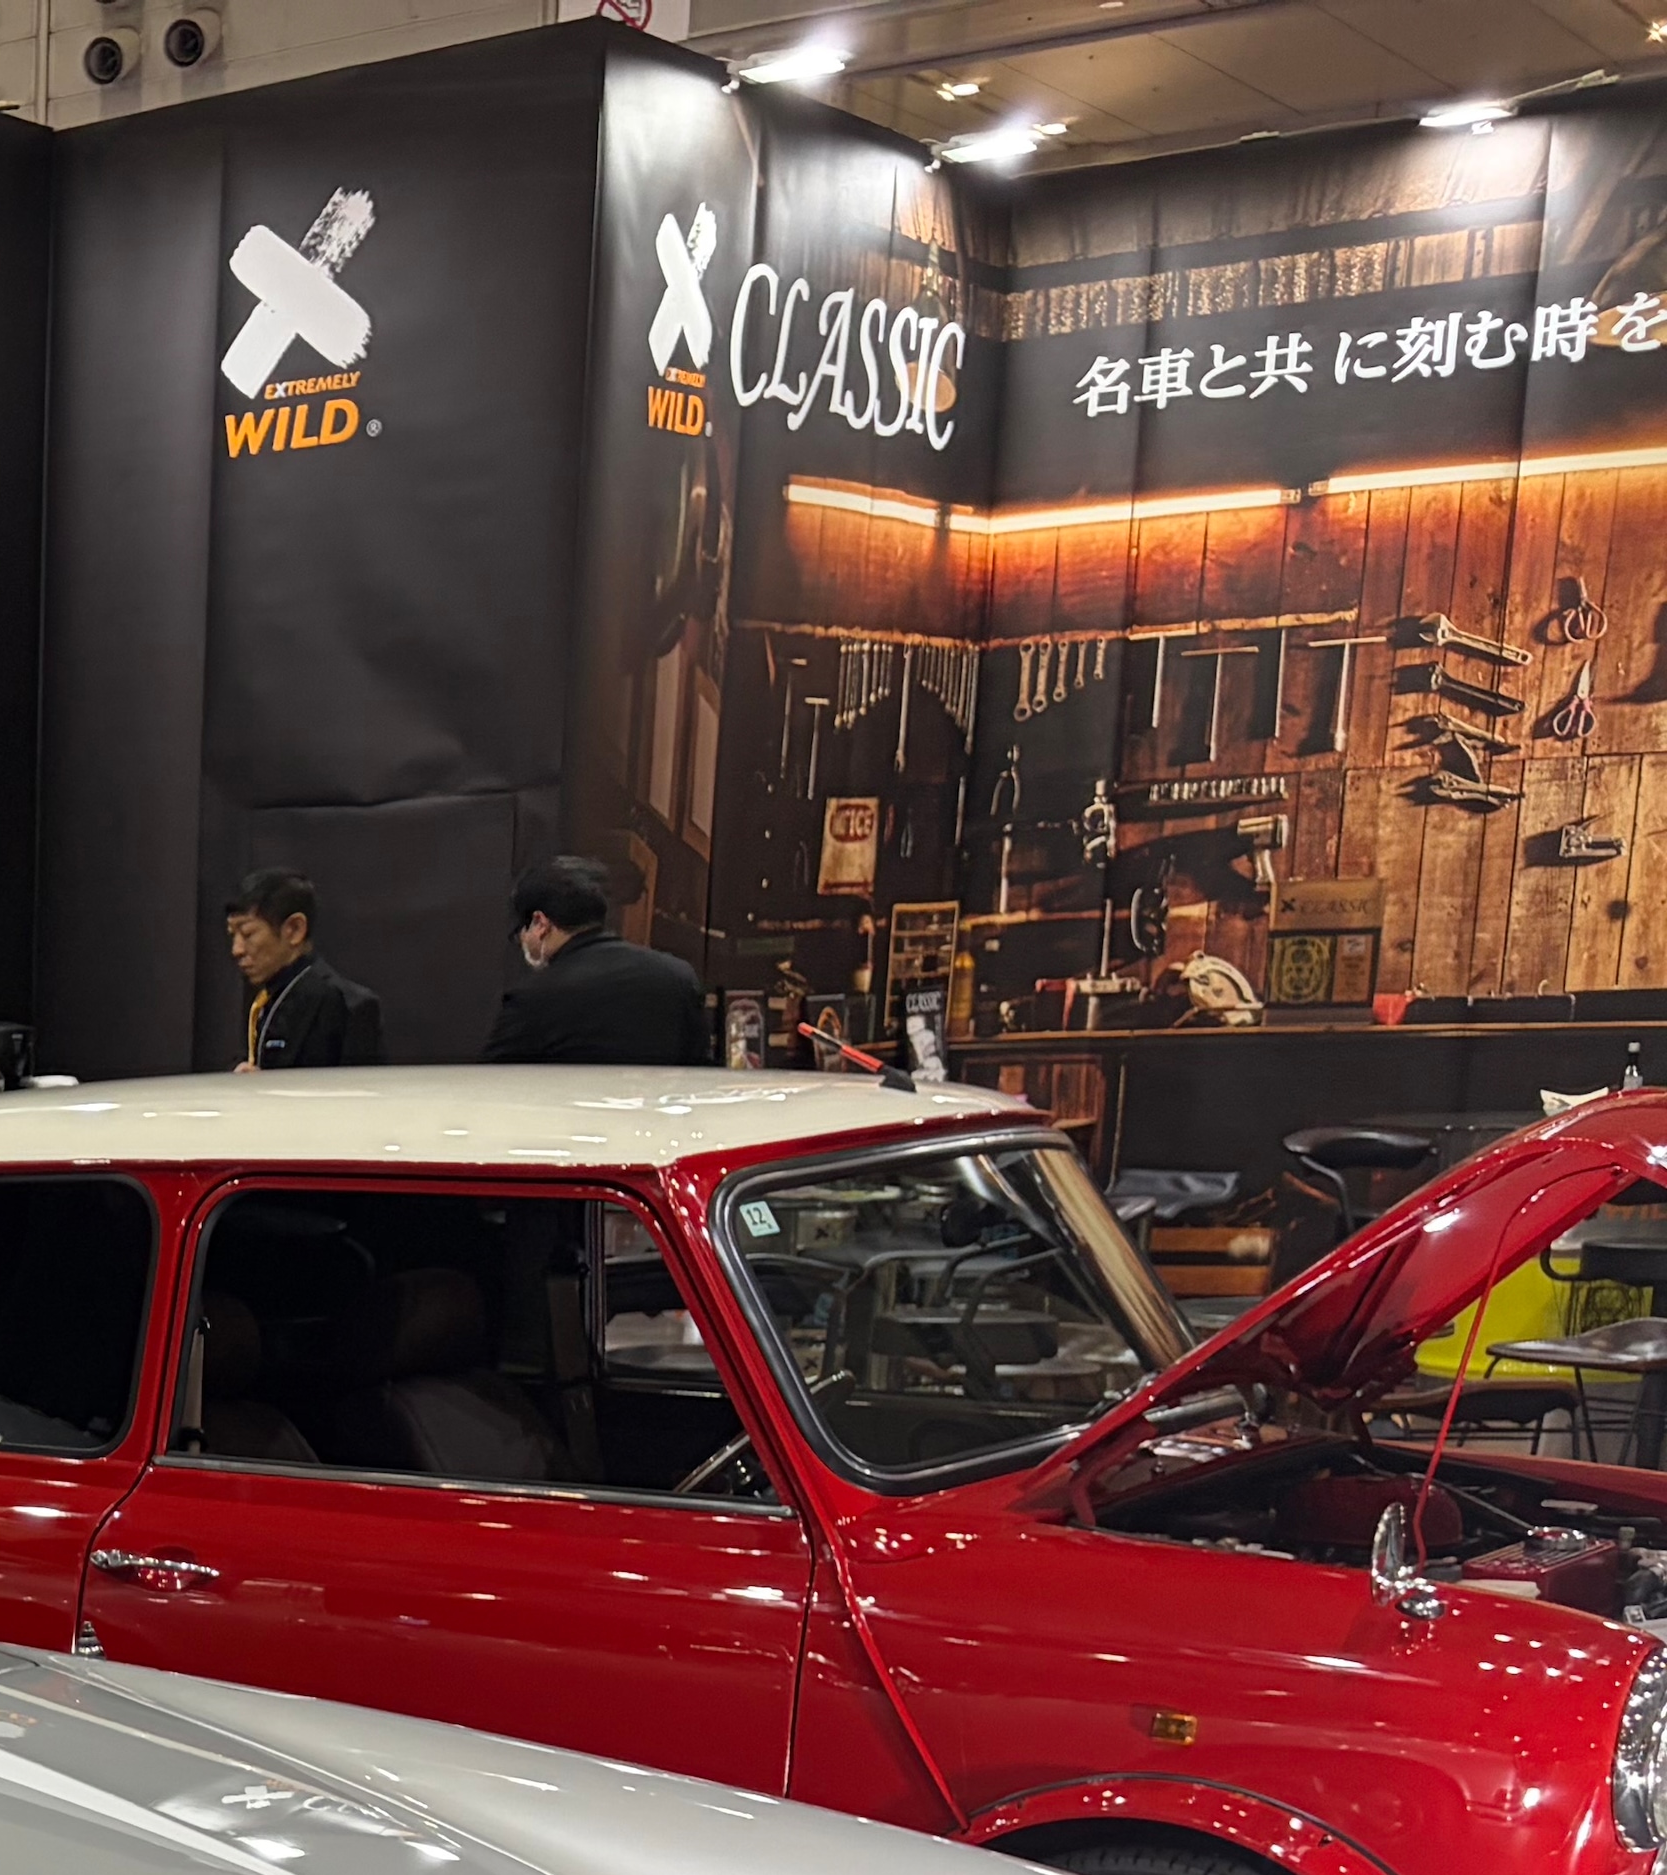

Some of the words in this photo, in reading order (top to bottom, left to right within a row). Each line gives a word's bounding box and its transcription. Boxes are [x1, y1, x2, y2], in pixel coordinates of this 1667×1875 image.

[728, 262, 966, 450] CLASSIC
[264, 371, 362, 400] EXTREMELY
[647, 385, 705, 436] WILD
[225, 398, 360, 458] WILD
[746, 1206, 767, 1226] 12
